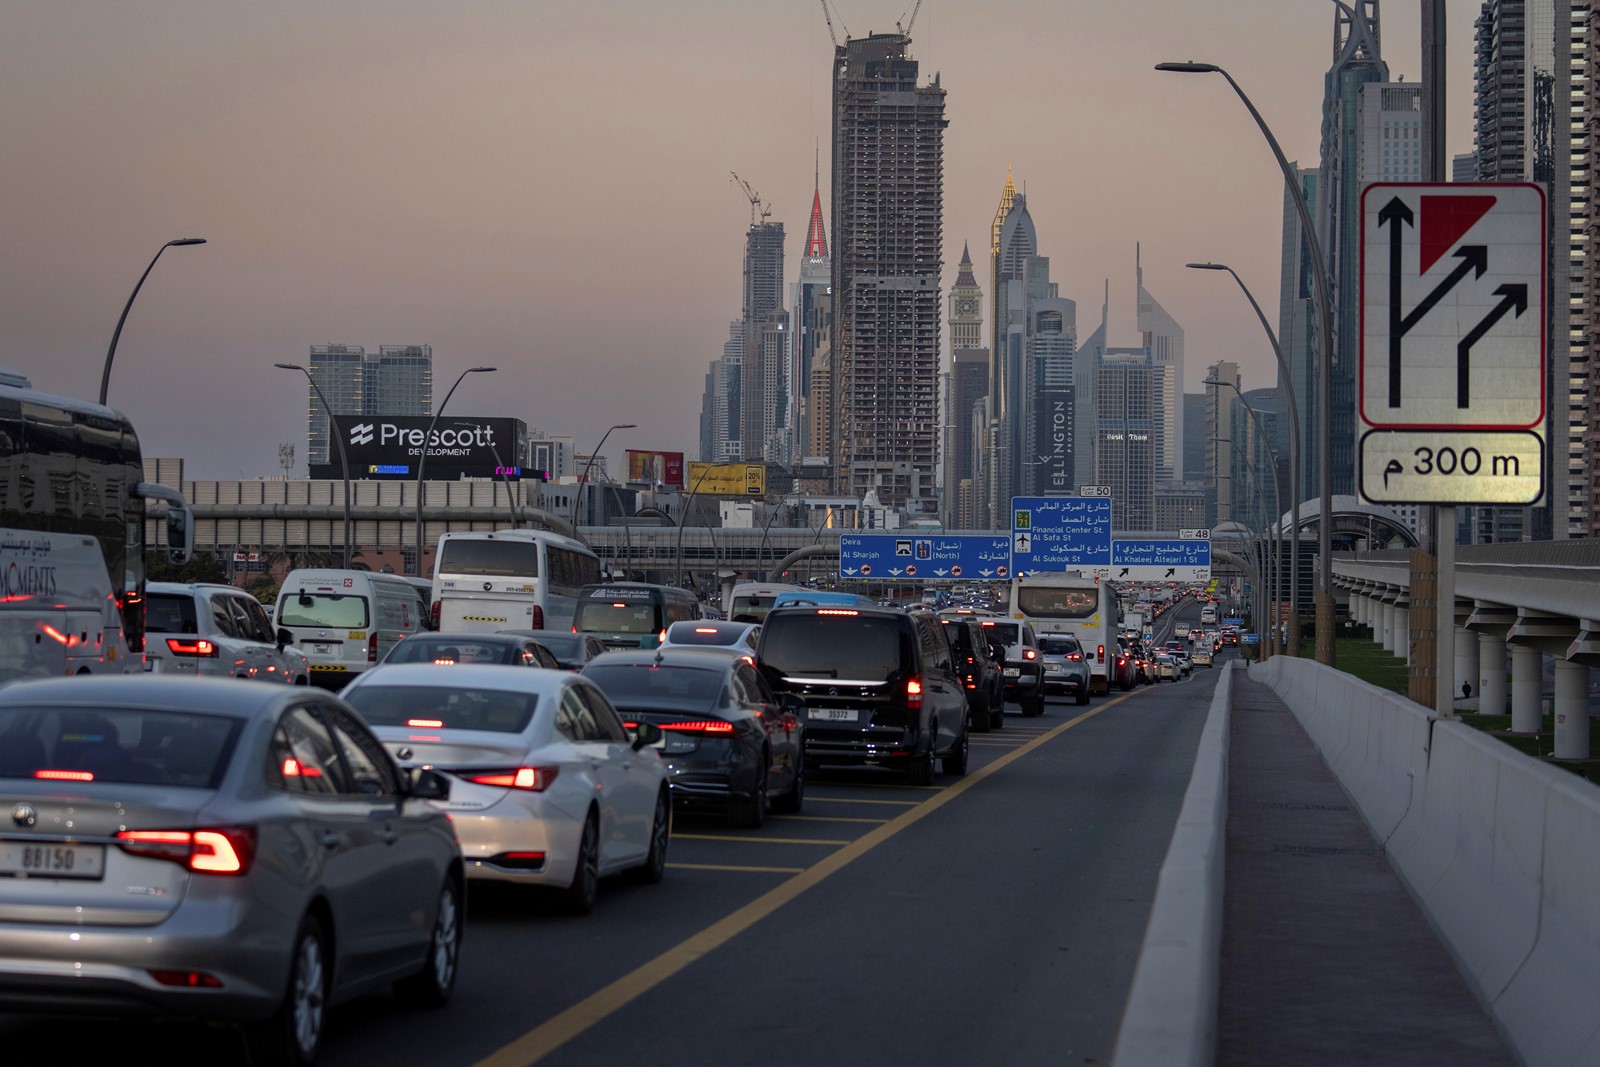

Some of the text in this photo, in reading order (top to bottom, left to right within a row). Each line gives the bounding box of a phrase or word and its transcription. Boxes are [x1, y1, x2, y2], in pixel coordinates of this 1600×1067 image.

[380, 424, 496, 446] Prescott
[1053, 401, 1065, 486] ELLINGTON
[1383, 446, 1520, 492] م 300 m
[1097, 487, 1109, 495] 50
[1036, 502, 1110, 513] شارع المركز المالي
[1018, 519, 1028, 527] 71
[1086, 515, 1109, 525] شارع
[1195, 530, 1208, 538] 48
[932, 540, 961, 550] (شمال)
[1050, 544, 1109, 554] شارع الصكوك
[1122, 545, 1154, 554] التجاري
[1156, 545, 1184, 554] الخليج
[1186, 545, 1208, 555] شارع
[919, 549, 927, 557] 11
[978, 553, 1008, 561] الشارقة
[0, 562, 56, 598] MOMENTS
[829, 709, 849, 718] 35372
[22, 846, 74, 870] 88150
